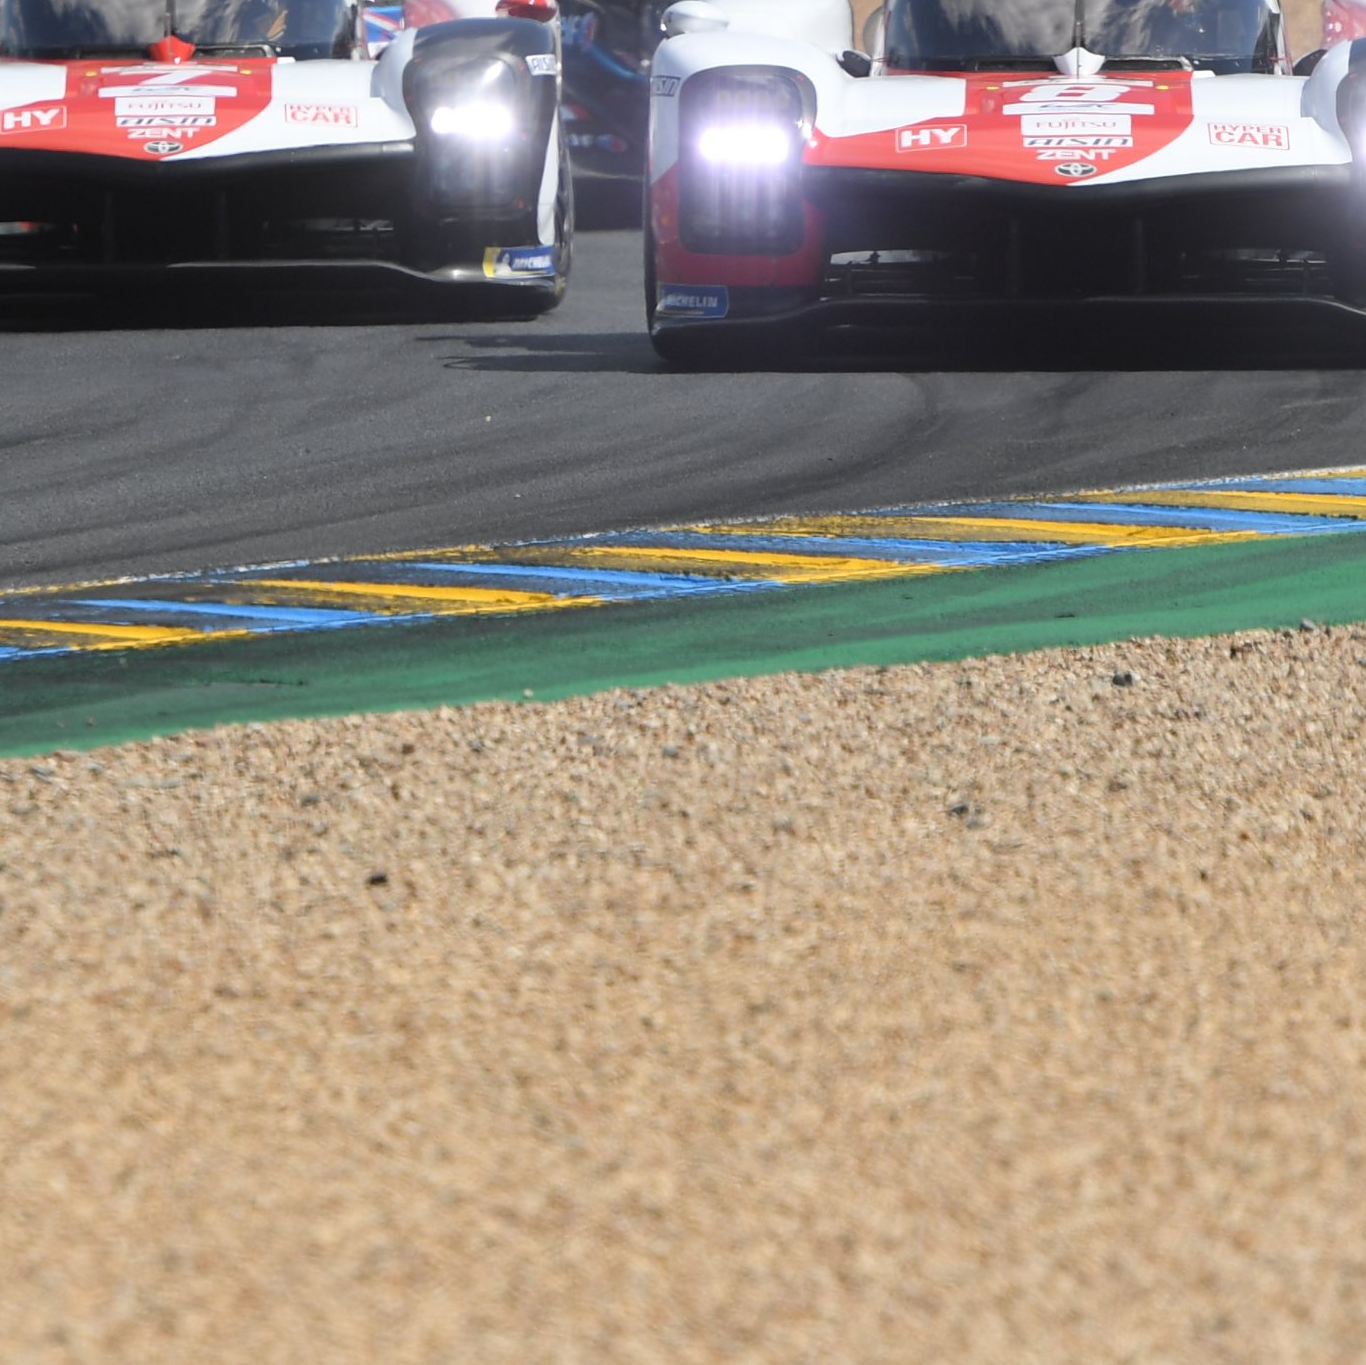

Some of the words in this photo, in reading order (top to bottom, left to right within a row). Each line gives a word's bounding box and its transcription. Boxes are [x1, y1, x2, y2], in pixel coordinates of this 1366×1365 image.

[1019, 84, 1131, 102] 8
[128, 100, 202, 111] FUJITSU
[3, 108, 60, 129] HY
[291, 110, 351, 124] CAR
[1036, 120, 1117, 130] FUJITSU
[1214, 124, 1282, 134] HYPER
[127, 127, 201, 139] ZENT
[901, 127, 961, 147] HY
[1215, 131, 1283, 146] CAR
[1036, 149, 1116, 160] ZENT
